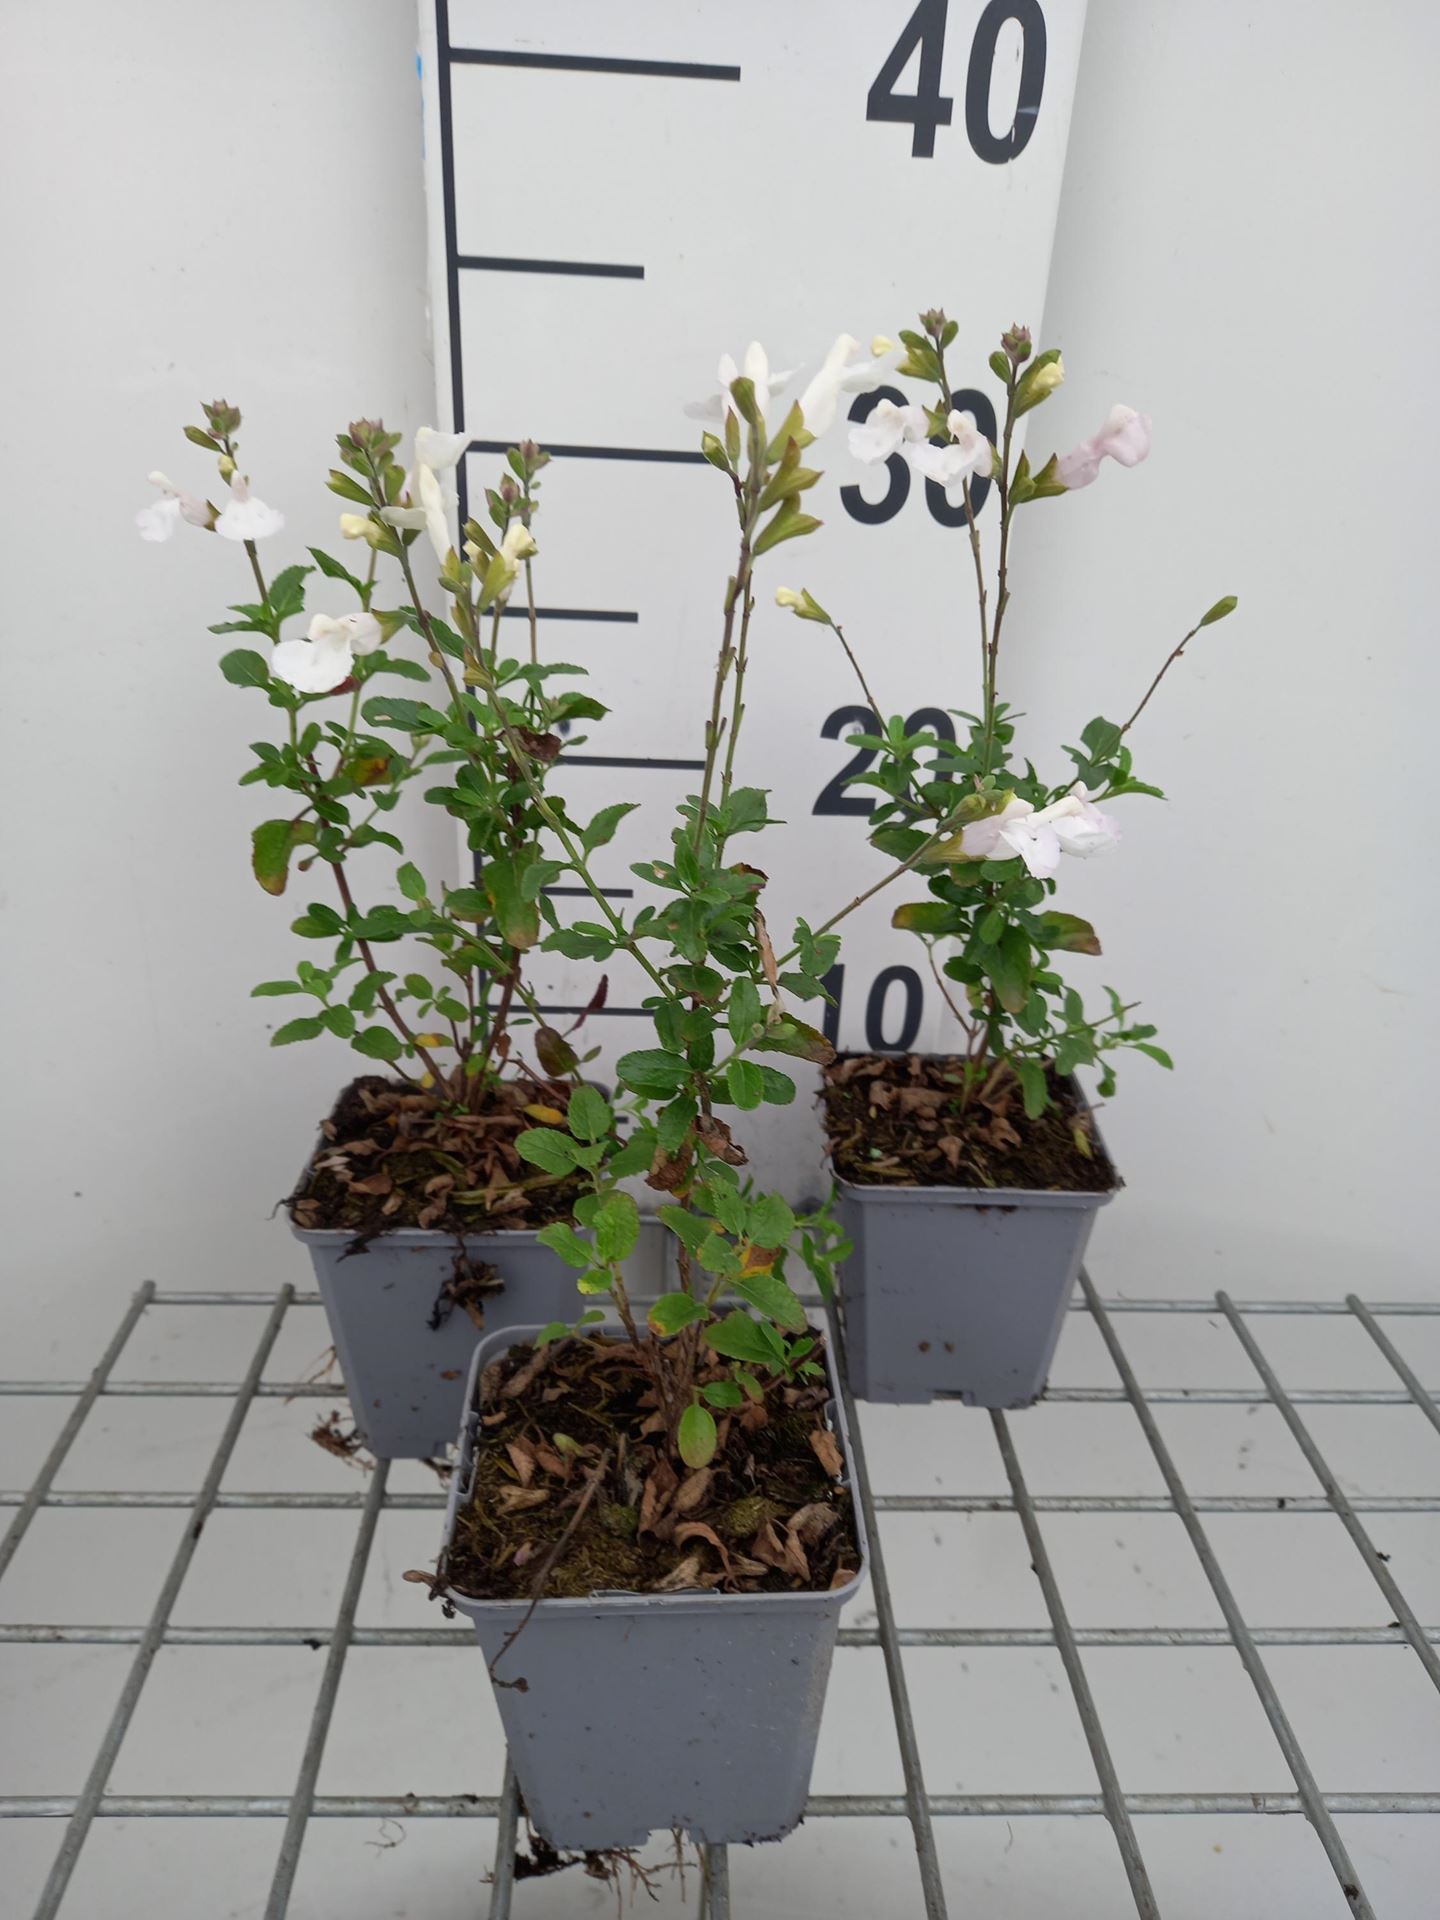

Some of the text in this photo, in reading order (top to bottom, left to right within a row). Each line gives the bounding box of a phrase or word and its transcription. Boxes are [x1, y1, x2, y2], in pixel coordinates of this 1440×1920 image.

[866, 0, 1047, 164] 40
[840, 385, 997, 528] 30
[812, 705, 956, 820] 20
[820, 964, 923, 1053] 10
